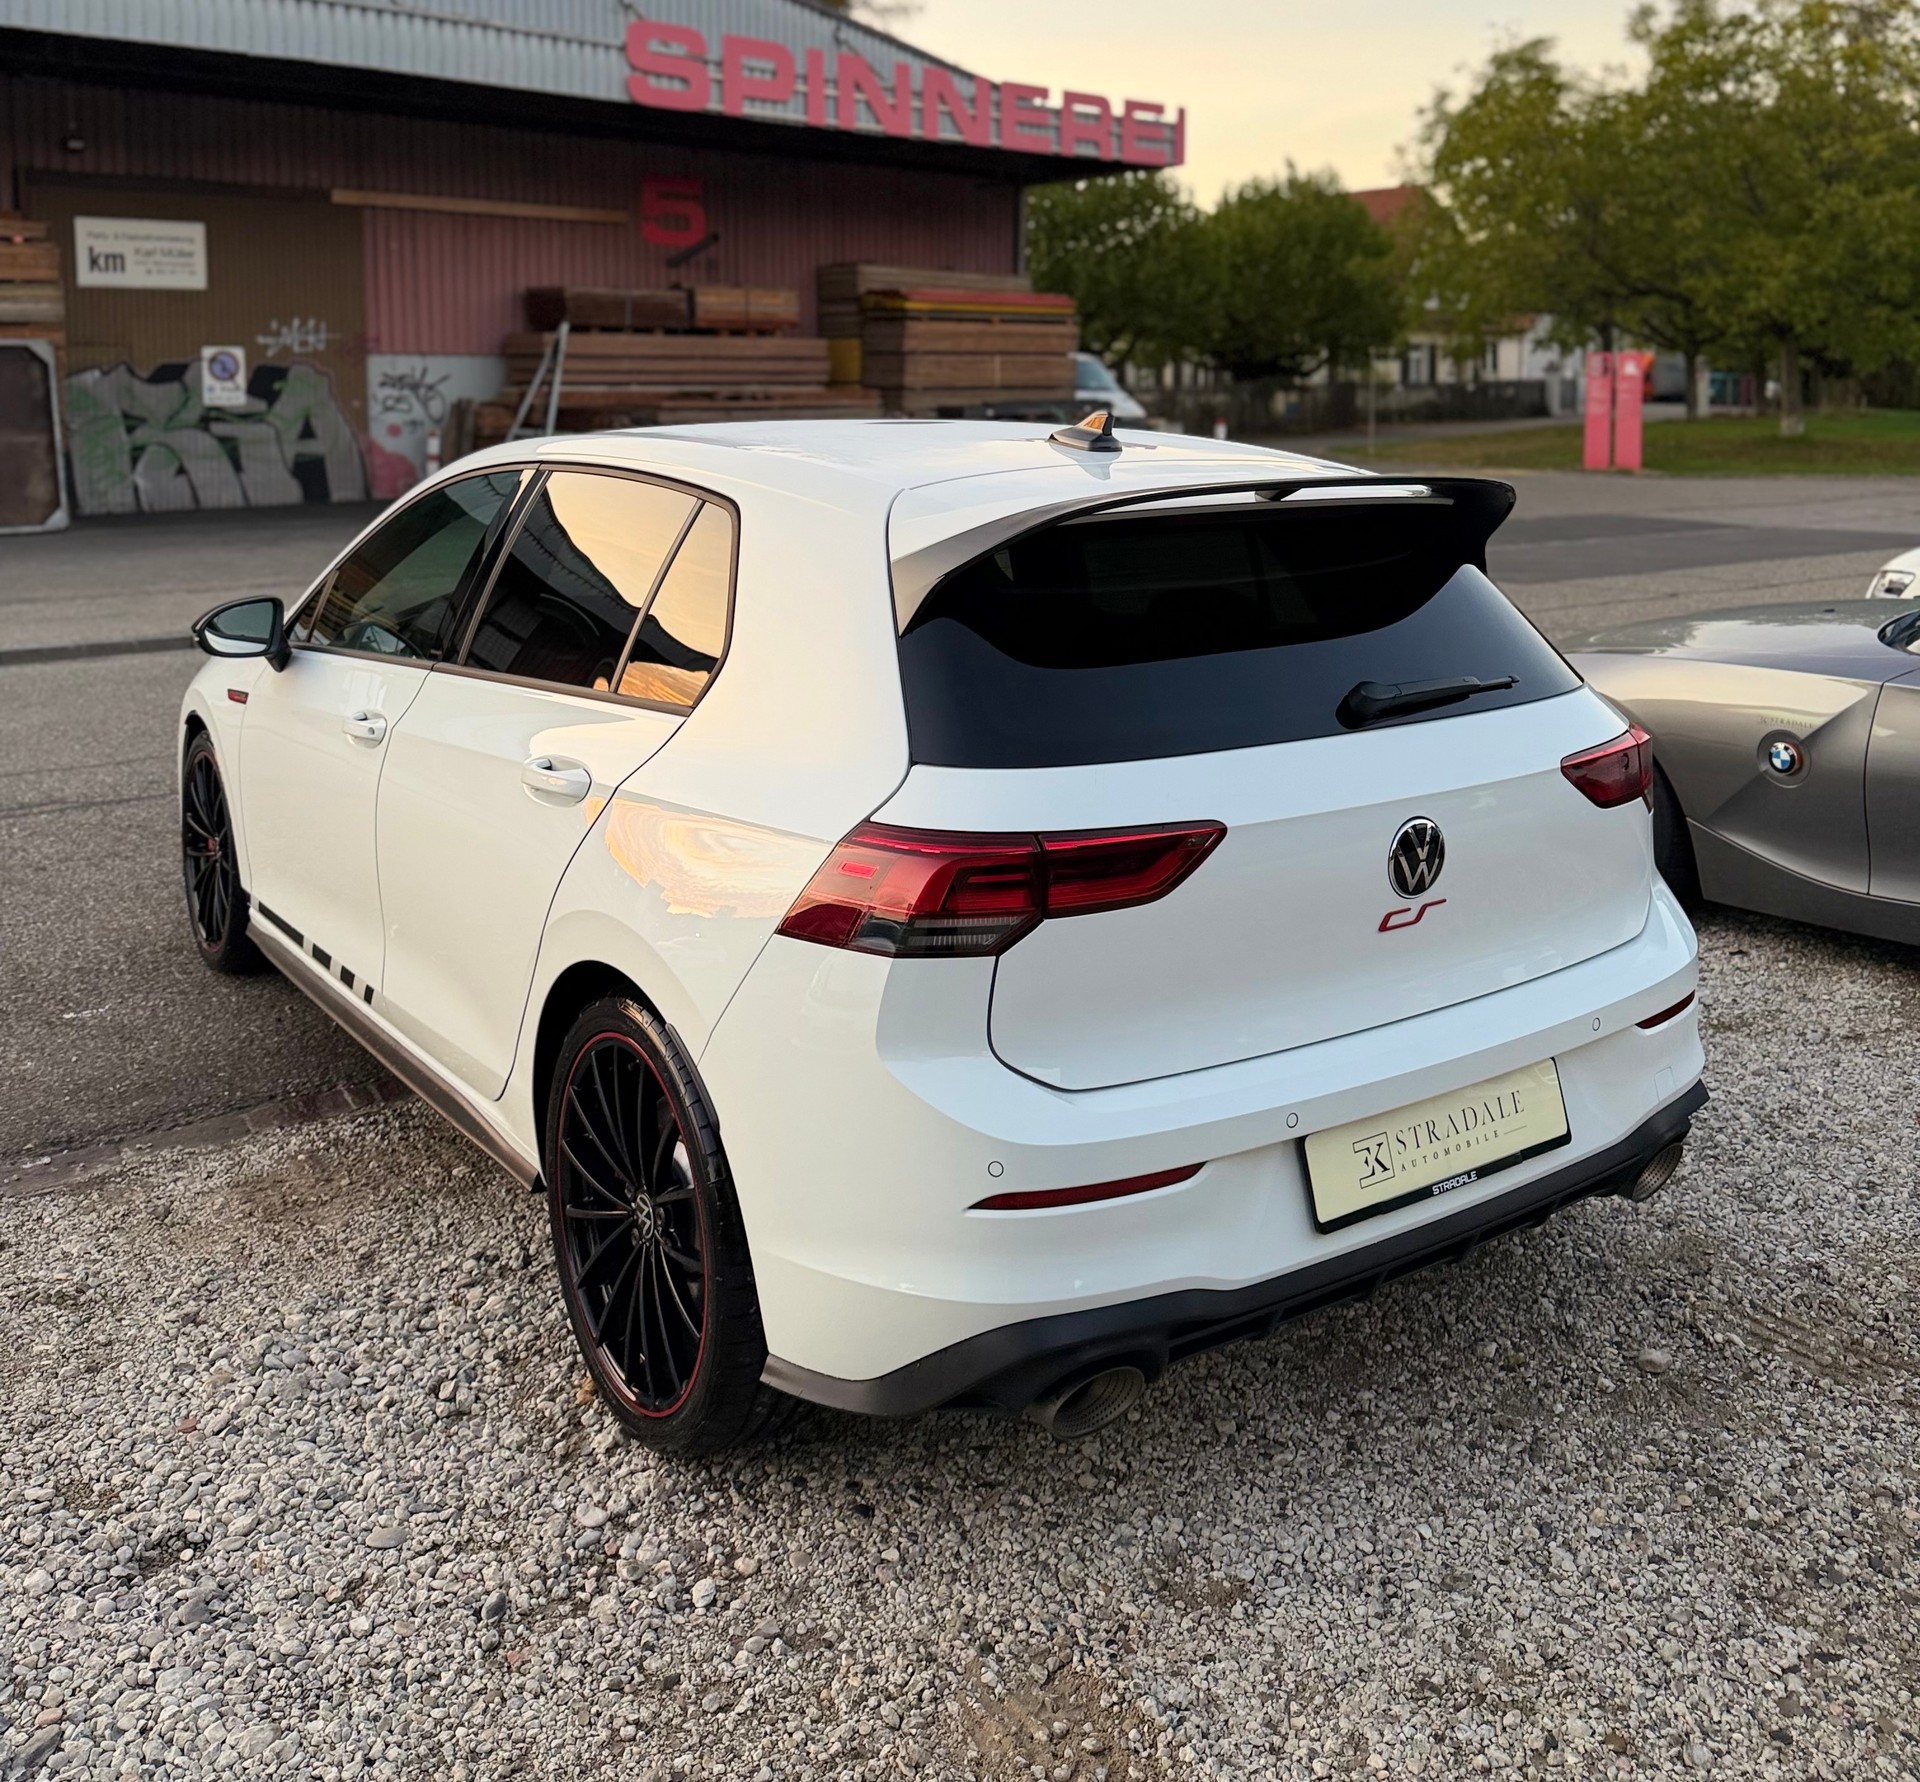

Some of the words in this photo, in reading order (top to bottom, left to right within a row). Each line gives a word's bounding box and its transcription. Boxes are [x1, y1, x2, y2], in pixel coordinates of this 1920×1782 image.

[626, 20, 1185, 168] SPINNEREI
[642, 177, 708, 247] 5
[88, 245, 126, 274] km
[1395, 1089, 1525, 1155] STRADALE
[1401, 1129, 1500, 1172] AUTOMOBILE
[1432, 1170, 1478, 1196] STRADALE
